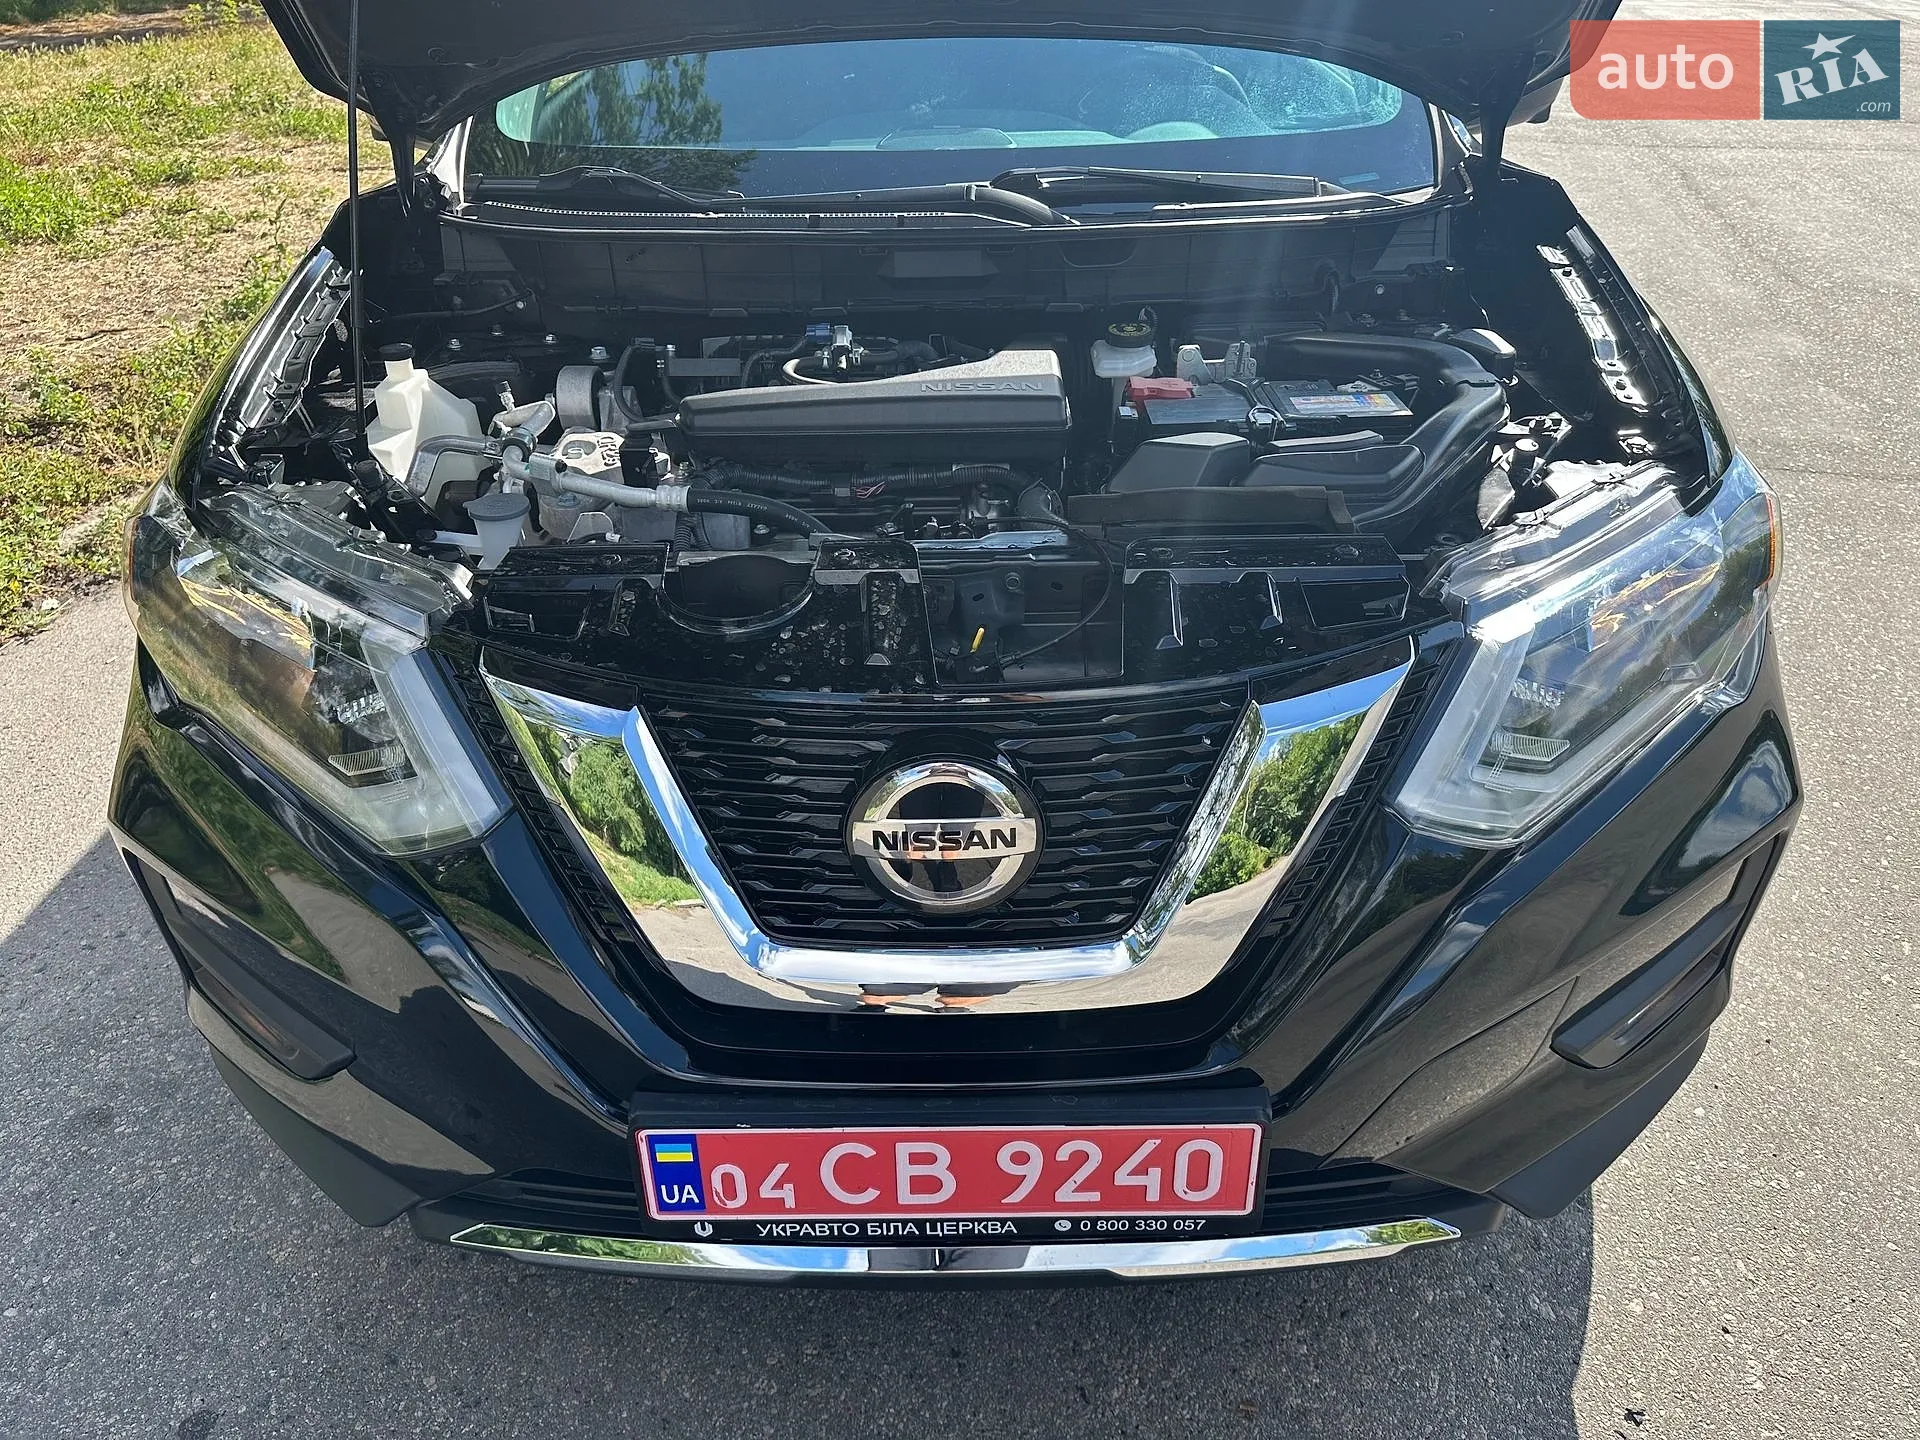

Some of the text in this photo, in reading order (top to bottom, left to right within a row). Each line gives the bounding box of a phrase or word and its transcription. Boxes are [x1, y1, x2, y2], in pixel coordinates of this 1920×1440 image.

[921, 382, 1044, 392] NISSAN
[872, 828, 1017, 851] NISSAN
[710, 1163, 796, 1209] 04
[996, 1139, 1224, 1204] 9240
[661, 1185, 700, 1204] UA
[756, 1220, 1018, 1238] УКРАВТО БІЛА ЦЕРКВА
[1080, 1219, 1207, 1232] 0 800 330 057
